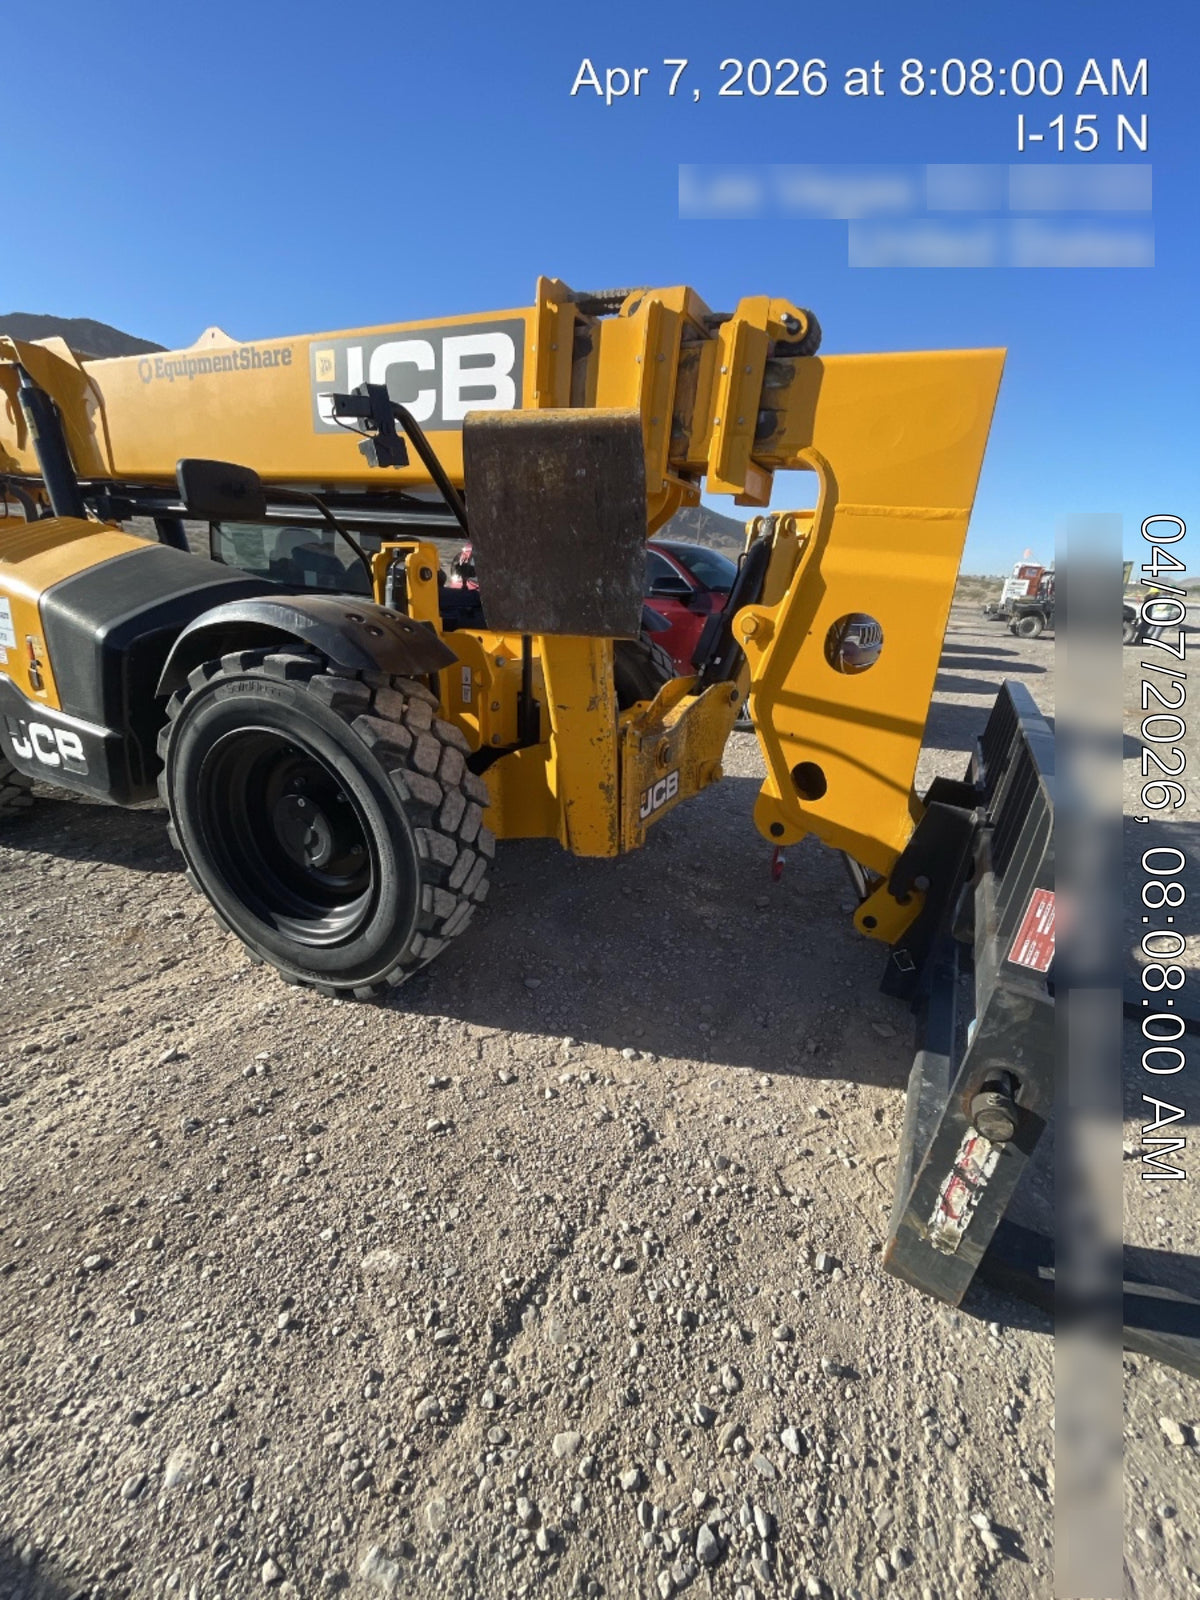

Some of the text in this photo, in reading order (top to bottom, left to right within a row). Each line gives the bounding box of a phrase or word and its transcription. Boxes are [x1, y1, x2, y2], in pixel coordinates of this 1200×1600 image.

[154, 345, 293, 381] EquipmentShare
[317, 332, 516, 425] JCB
[8, 716, 89, 775] JCB
[639, 770, 680, 819] JCB
